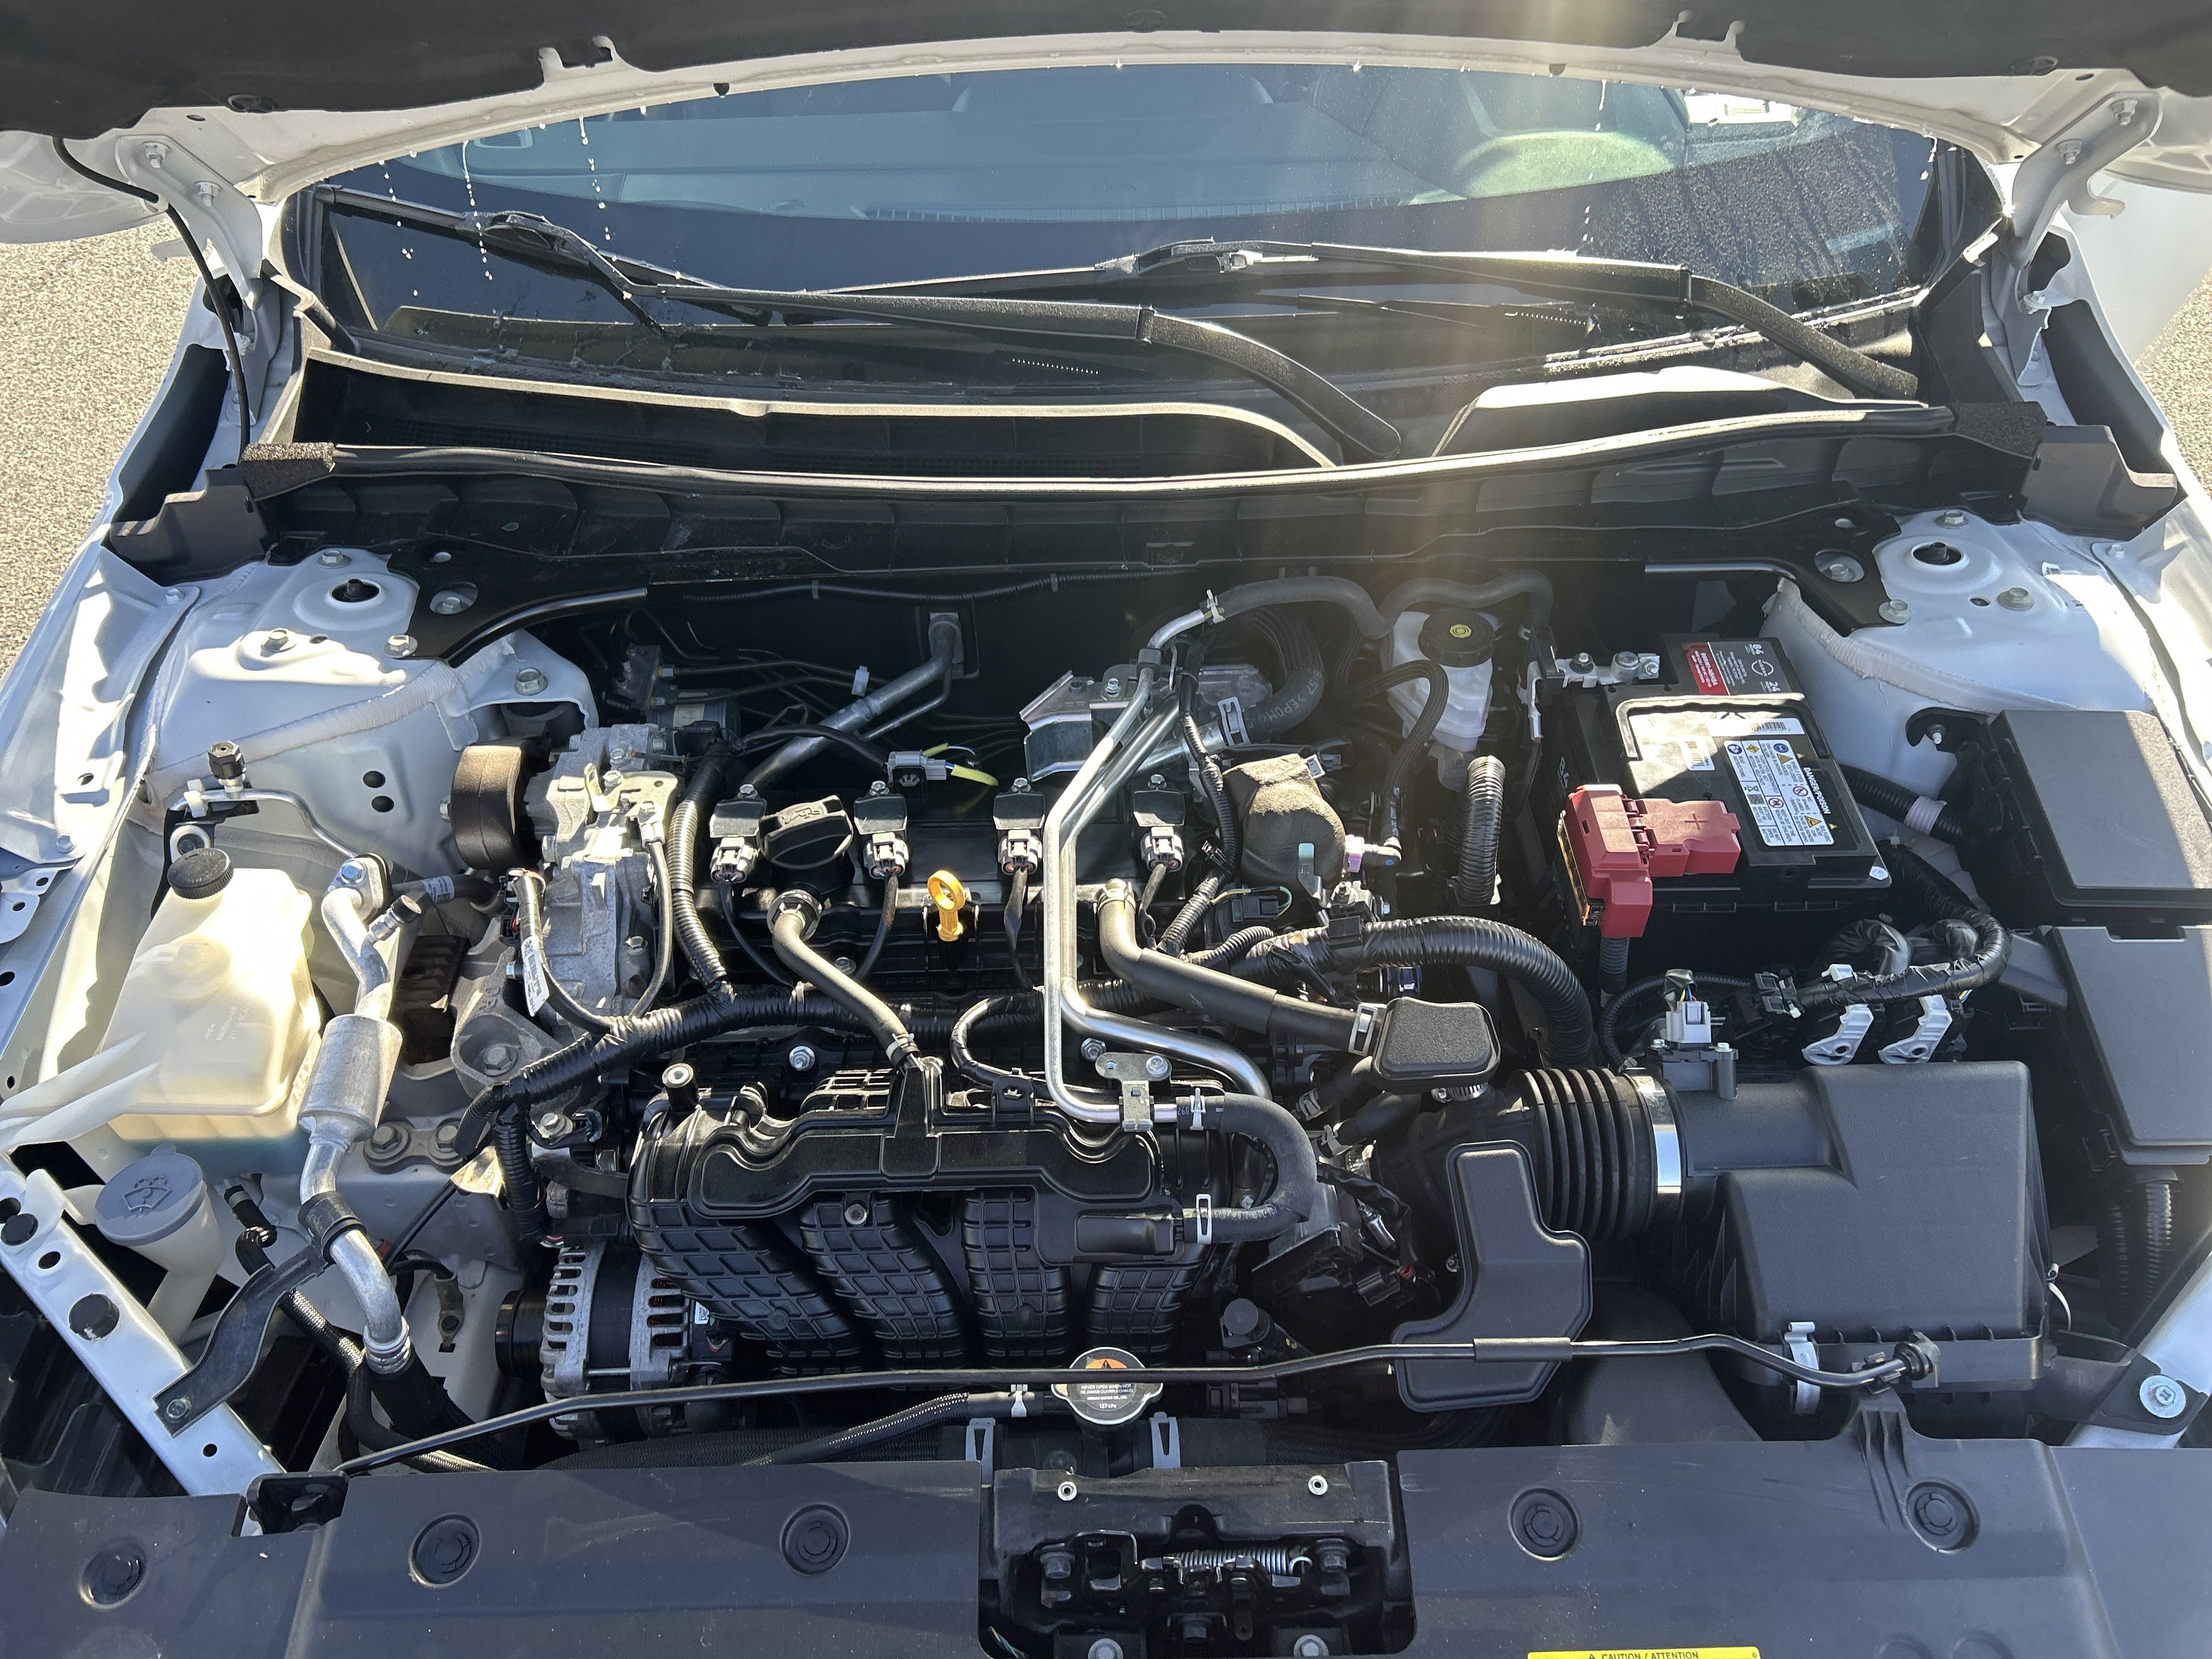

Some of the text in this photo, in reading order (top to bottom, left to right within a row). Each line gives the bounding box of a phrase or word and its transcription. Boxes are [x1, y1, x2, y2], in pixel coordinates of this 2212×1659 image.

[1757, 659, 1767, 676] NISSAN
[1803, 767, 1830, 814] DANGER/POISON
[1820, 825, 1830, 842] SULFURIC
